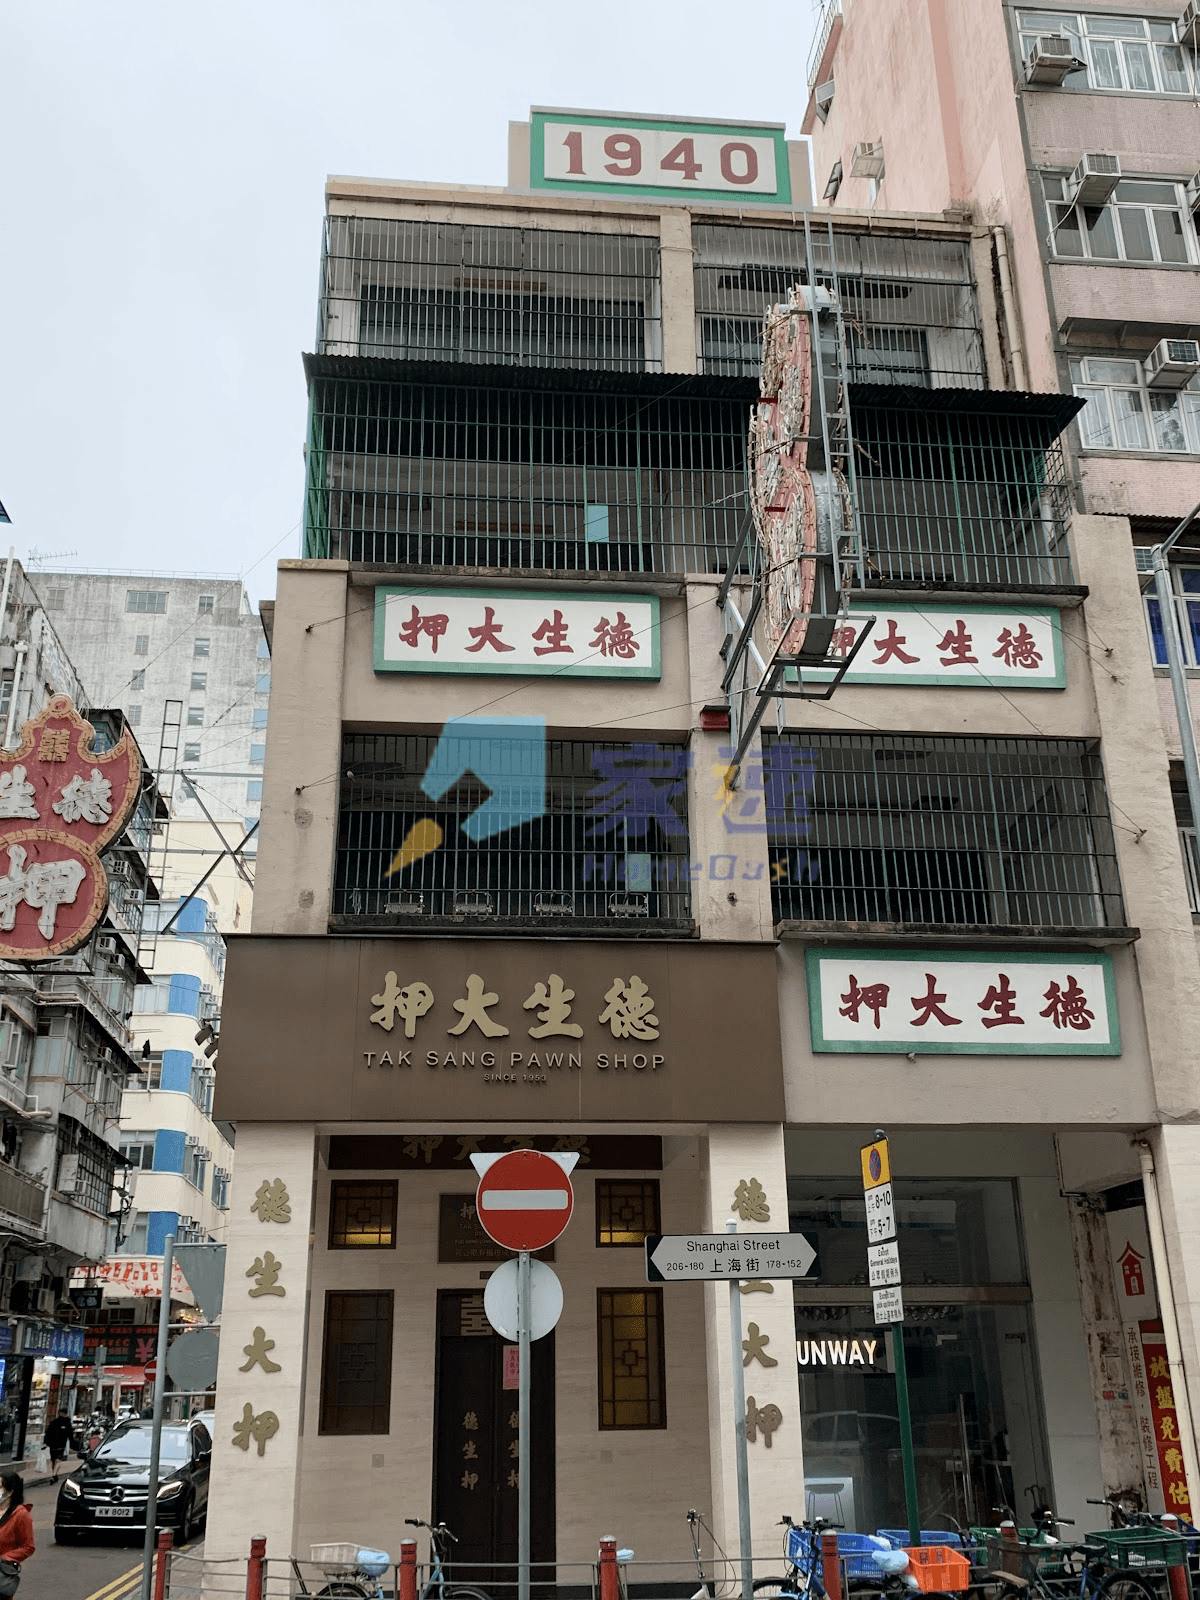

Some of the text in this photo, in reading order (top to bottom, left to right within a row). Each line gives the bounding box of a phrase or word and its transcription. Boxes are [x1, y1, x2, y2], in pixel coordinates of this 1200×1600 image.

[562, 131, 758, 185] 1940
[364, 1050, 665, 1069] TAK SANG PAWN SHOP
[484, 1073, 518, 1082] SINCE
[686, 1239, 780, 1253] Shanghai Street
[710, 1258, 760, 1273] 上海街
[232, 1177, 293, 1457] 德生大押
[112, 1508, 130, 1516] 8012
